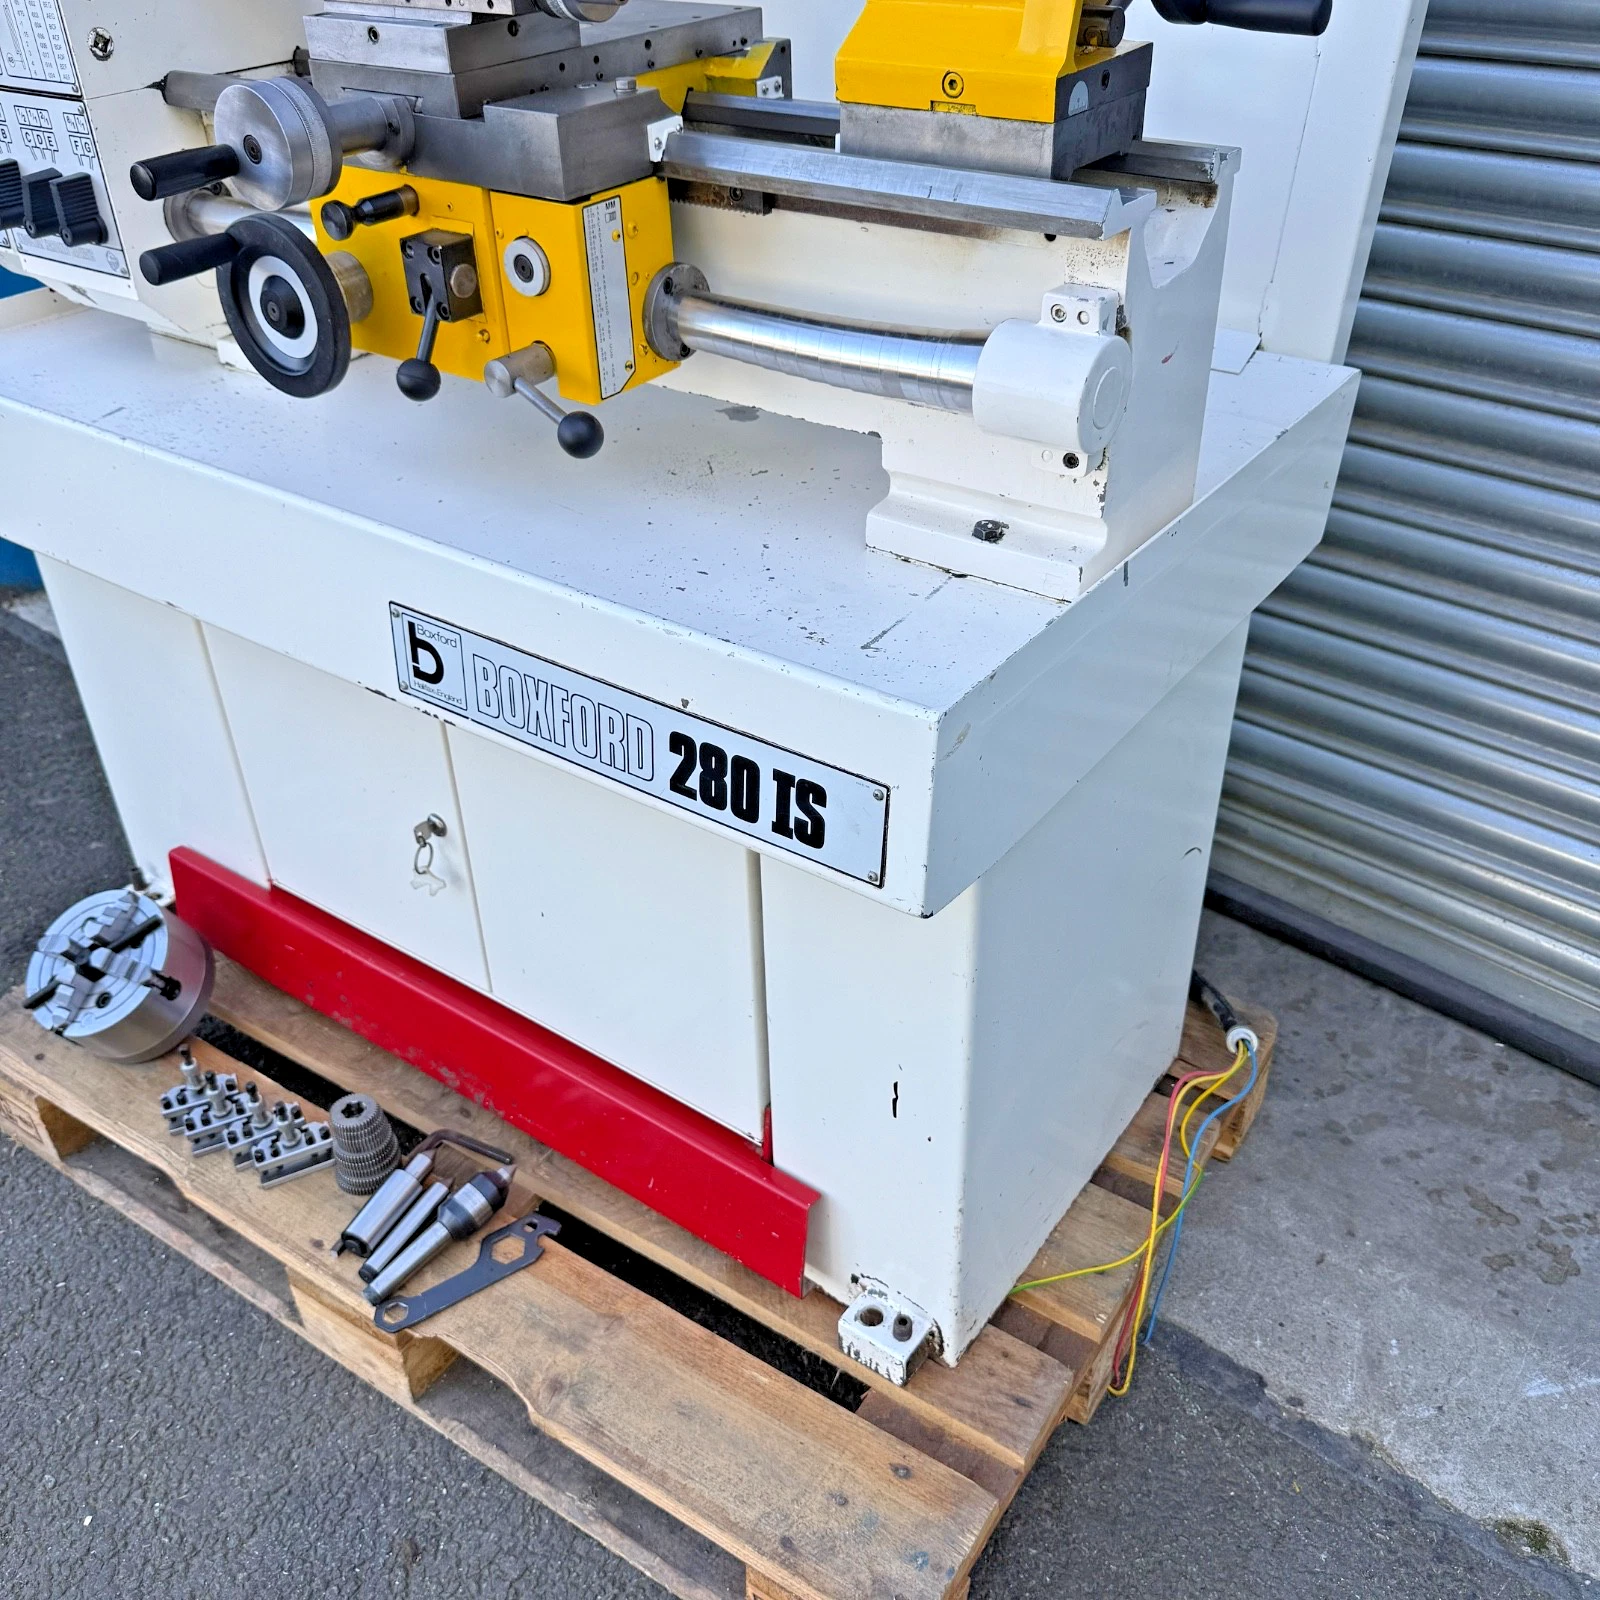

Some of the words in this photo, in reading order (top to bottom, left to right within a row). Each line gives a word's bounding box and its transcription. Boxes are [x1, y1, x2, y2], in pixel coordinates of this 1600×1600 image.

[1, 128, 7, 139] B
[24, 132, 32, 143] C
[36, 134, 43, 145] D
[47, 136, 54, 147] E
[74, 140, 80, 151] F
[84, 142, 92, 153] G
[416, 624, 457, 648] Boxford
[473, 653, 654, 782] BOXFORD
[669, 731, 760, 824] 280
[771, 768, 827, 849] IS
